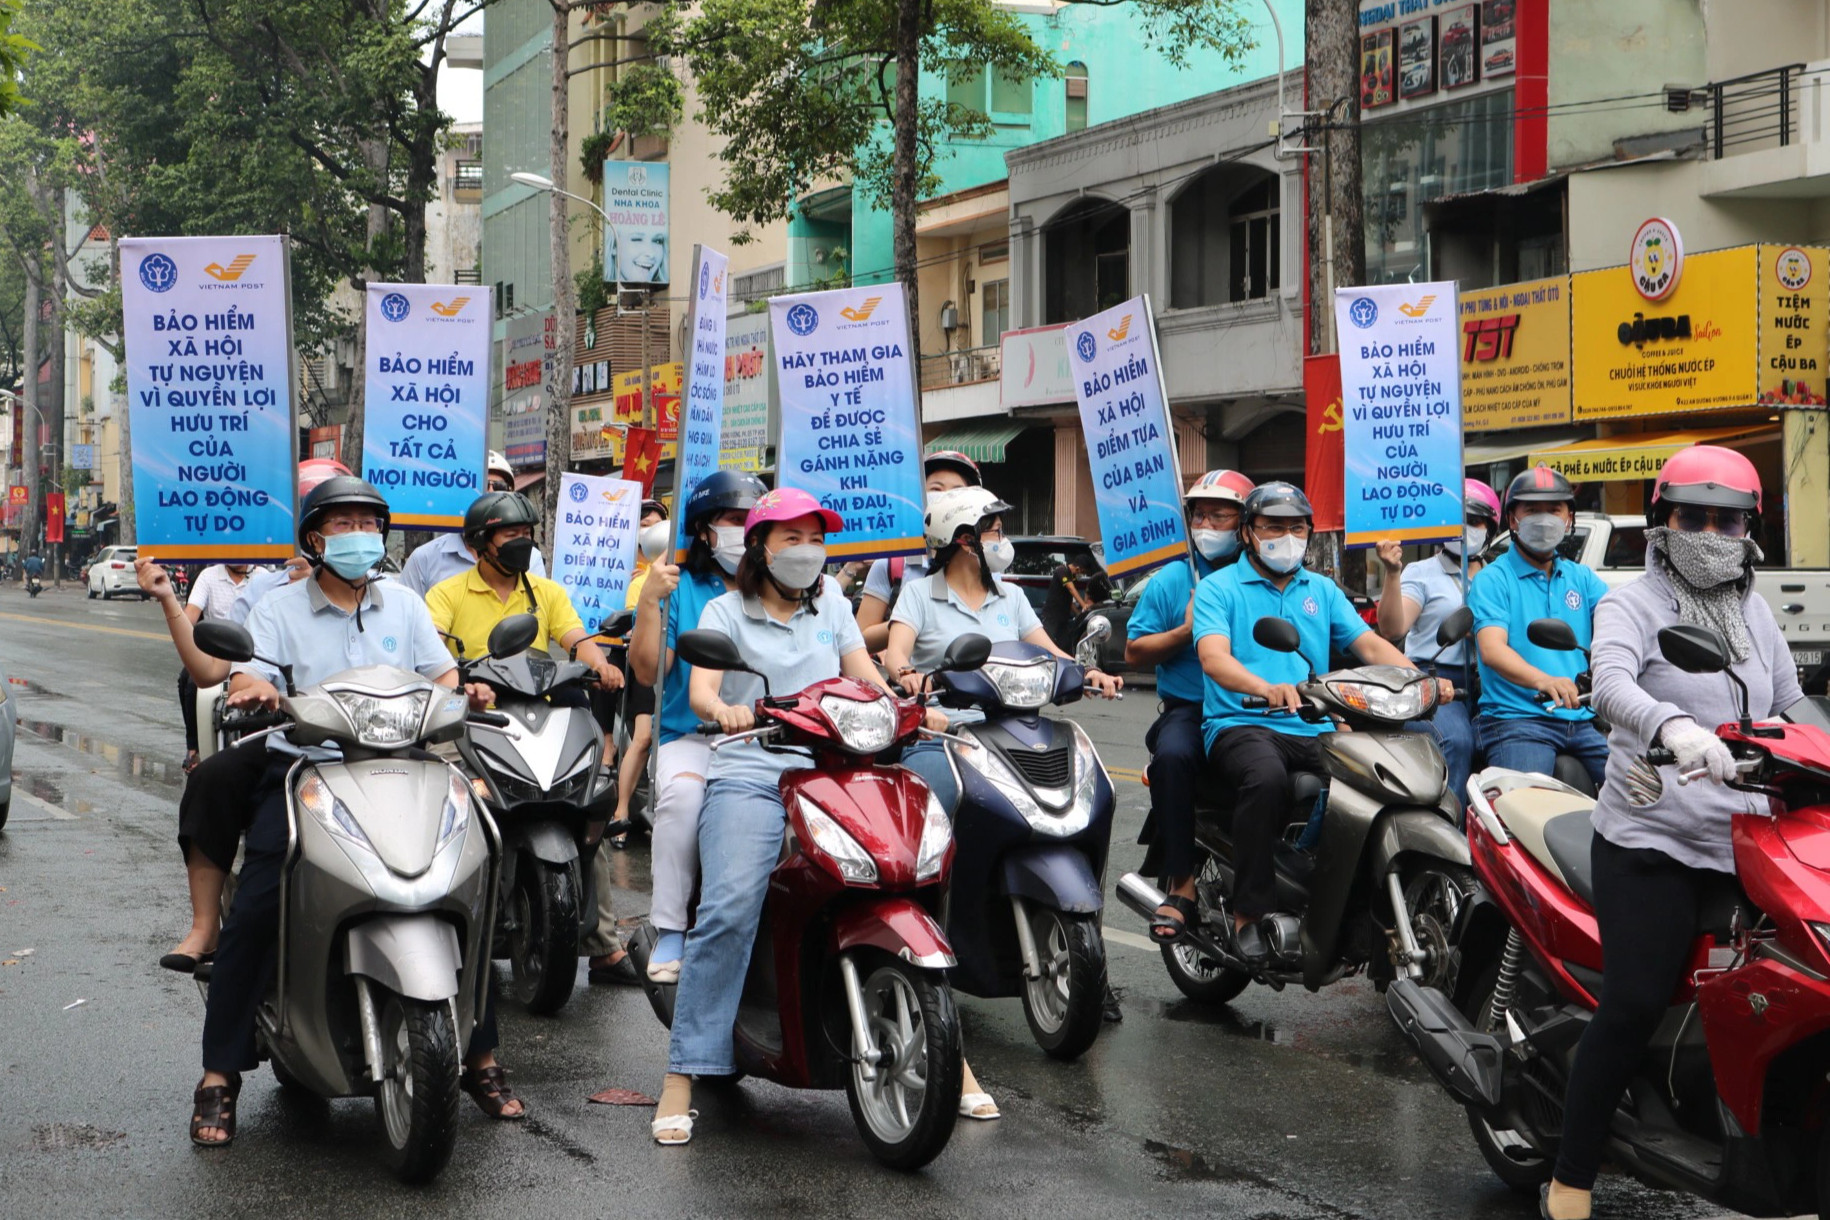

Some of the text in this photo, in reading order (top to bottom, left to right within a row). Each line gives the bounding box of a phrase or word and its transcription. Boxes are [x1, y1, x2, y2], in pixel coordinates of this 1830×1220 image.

[611, 187, 663, 198] Dental Clinic
[613, 199, 660, 209] NHA KHOA
[609, 209, 666, 227] HOÀNG LÊ
[1640, 272, 1669, 293] CẬU BA
[1465, 301, 1476, 316] PHỤ
[1478, 297, 1492, 313] TÙNG
[1513, 292, 1531, 308] NGOẠI
[1532, 285, 1546, 304] THẤT
[1776, 294, 1811, 312] TIỆM
[153, 304, 255, 331] BẢO HIỂM
[1775, 314, 1810, 329] NƯỚC
[168, 334, 243, 360] XÃ HỘI
[1107, 335, 1141, 353] VIETNAM POST
[1361, 335, 1435, 359] BẢO HIỂM
[1463, 314, 1519, 362] TST
[1786, 334, 1802, 349] ÉP
[379, 350, 474, 376] BẢO HIỂM
[782, 344, 903, 369] HÃY THAM GIA
[1642, 348, 1684, 358] COFFEE JUICE
[1770, 353, 1817, 373] CẬU BA
[149, 360, 264, 387] TỰ NGUYỆN
[804, 361, 884, 389] BẢO HIỂM
[1083, 371, 1111, 398] BẢO
[1113, 353, 1149, 384] HIỂM
[1372, 359, 1426, 380] XÃ HỘI
[1509, 365, 1530, 376] ANDROID
[1648, 359, 1677, 377] THỐNG
[1678, 358, 1703, 374] NƯỚC
[1704, 358, 1715, 372] ÉP
[703, 382, 717, 401] SỐNG
[1359, 379, 1441, 403] TỰ NGUYỆN
[1683, 377, 1697, 389] VIỆT
[140, 381, 276, 411] VÌ QUYỀN LỢI
[391, 382, 460, 408] XÃ HỘI
[831, 384, 863, 407] Y TẾ
[701, 406, 714, 422] DÂN
[1098, 392, 1146, 426] XÃ HỘI
[1352, 397, 1450, 421] VÌ QUYỀN LỢI
[1473, 403, 1487, 412] CÁCH
[1501, 400, 1511, 410] CAO
[171, 410, 249, 432] HƯU TRÍ
[402, 413, 448, 431] CHO
[811, 407, 886, 430] ĐỂ ĐƯỢC
[1373, 419, 1430, 439] HƯU TRÍ
[188, 434, 234, 457] CỦA
[389, 435, 457, 460] TẤT CẢ
[700, 432, 713, 446] QUA
[818, 426, 883, 450] CHIA SẺ
[1097, 423, 1159, 459] ĐIỂM TỰA
[1385, 440, 1418, 459] CỦA
[178, 461, 246, 482] NGƯỜI
[800, 450, 904, 473] GÁNH NẶNG
[1103, 454, 1165, 490] CỦA BẠN
[1377, 461, 1428, 480] NGƯỜI
[1564, 459, 1581, 476] PHÊ
[1583, 463, 1590, 474] &
[1592, 457, 1618, 474] NƯỚC
[1620, 456, 1632, 472] ÉP
[1634, 456, 1653, 476] CẬU
[368, 467, 477, 490] MỌI NGƯỜI
[840, 474, 868, 490] KHI
[158, 486, 269, 511] LAO ĐỘNG
[1362, 481, 1444, 501] LAO ĐỘNG
[820, 493, 893, 512] ỐM ĐAU,
[1128, 490, 1148, 514] VÀ
[565, 510, 630, 530] BẢO HIỂM
[866, 512, 895, 533] TẬT
[1380, 504, 1426, 523] TỰ DO
[184, 513, 245, 536] TỰ DO
[1113, 518, 1176, 552] GIA ĐÌNH
[572, 533, 620, 551] XÃ HỘI
[564, 550, 625, 572] ĐIỂM TỰA
[563, 571, 624, 592] CỦA BẠN
[583, 594, 600, 609] VÀ
